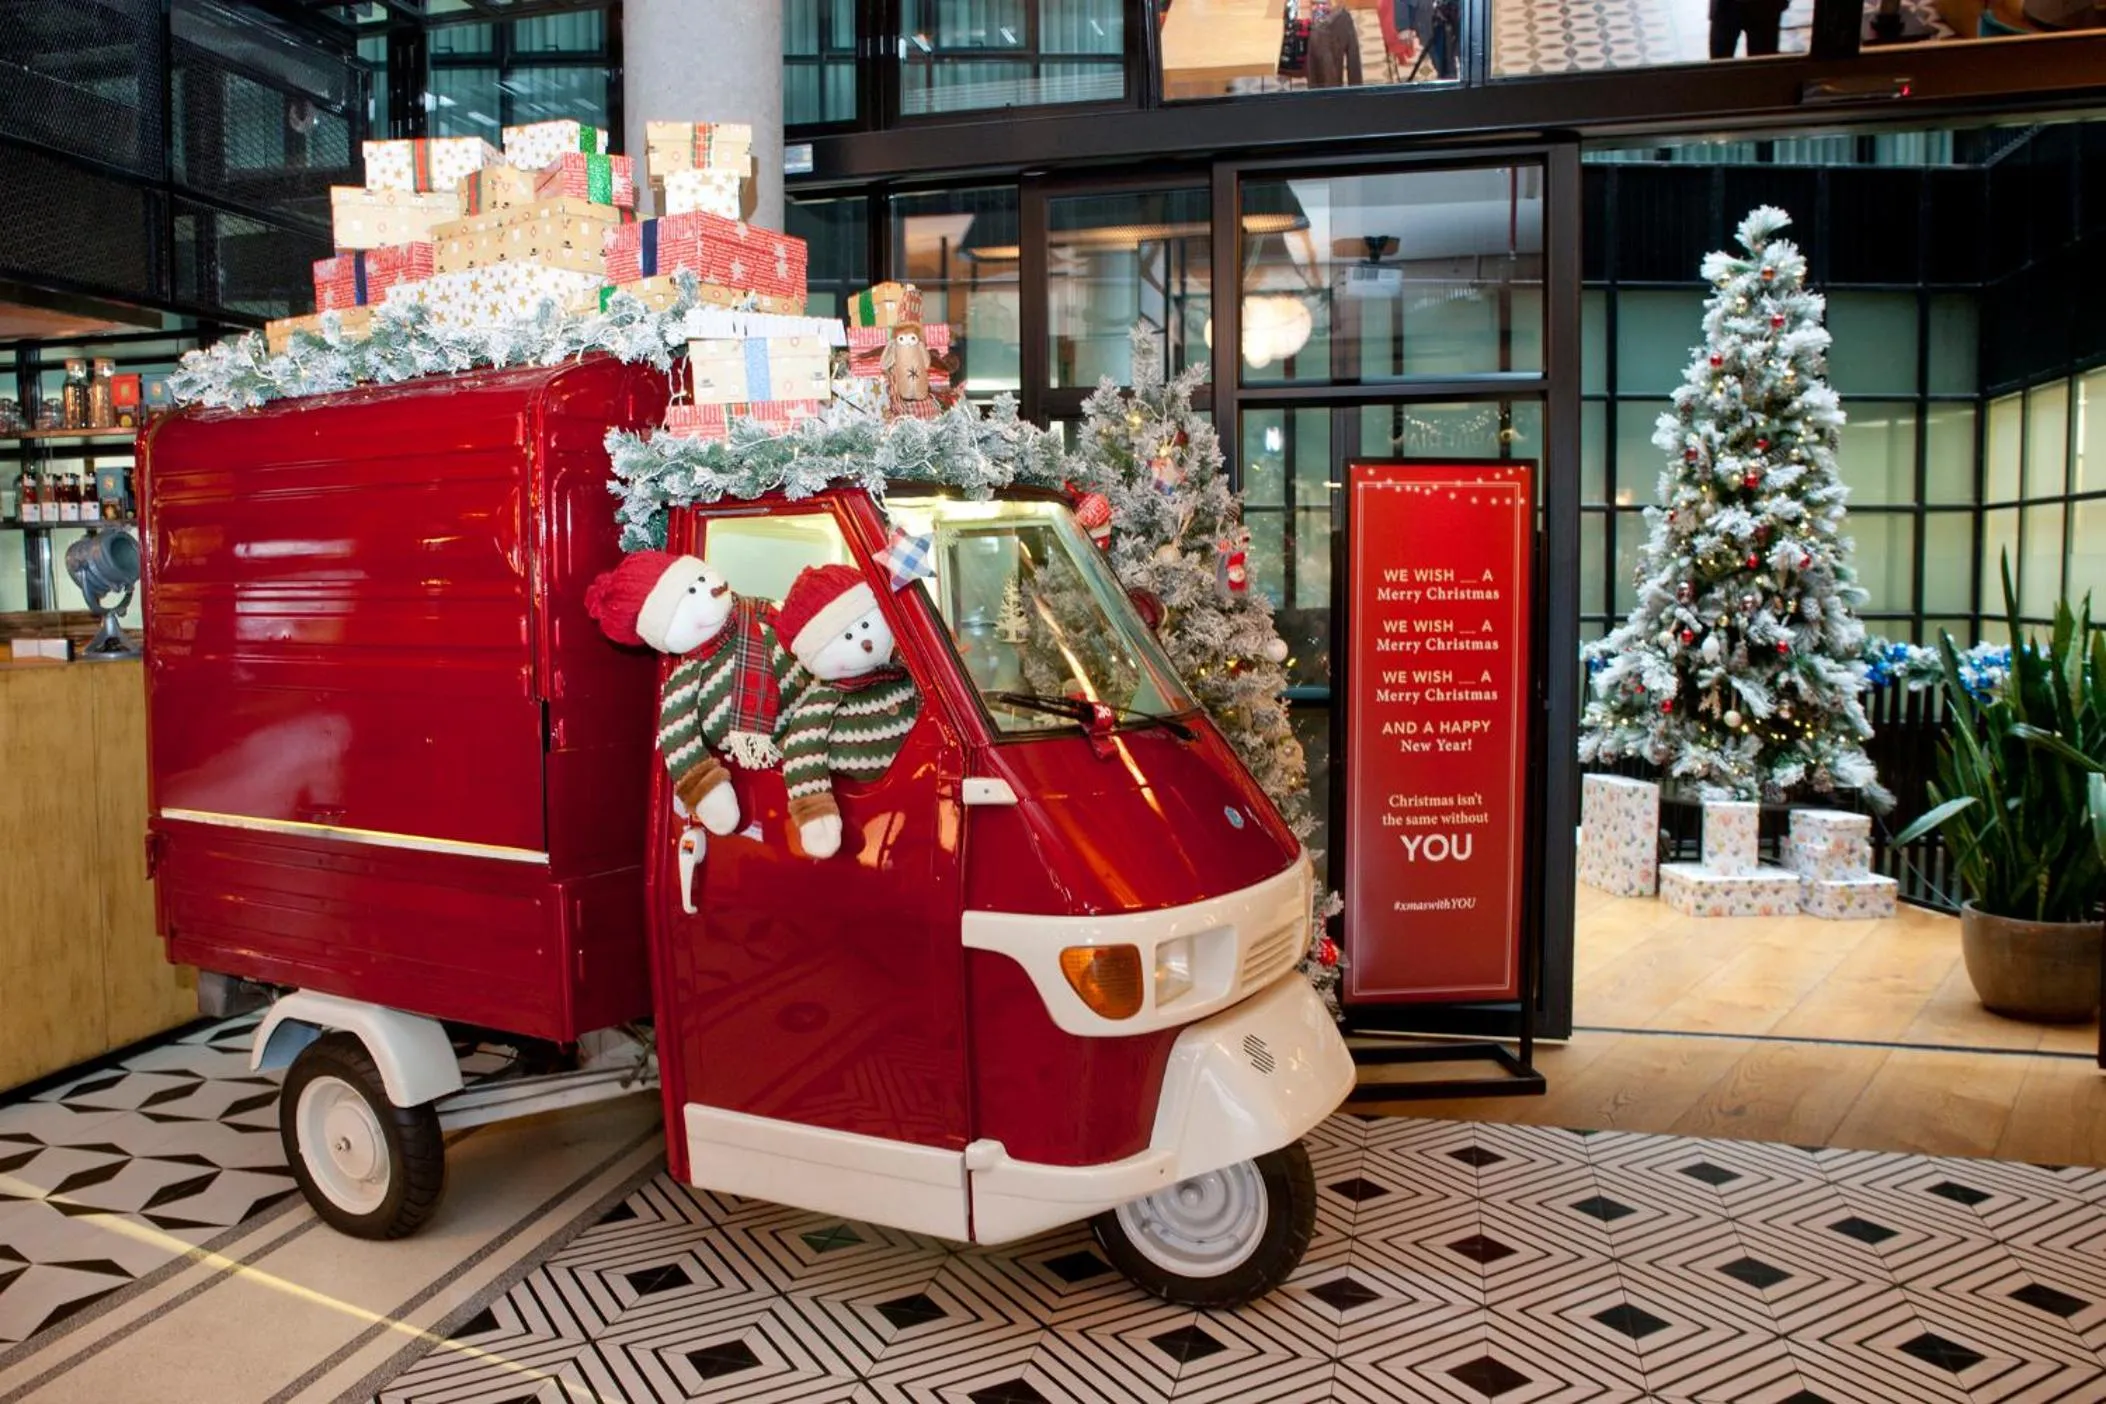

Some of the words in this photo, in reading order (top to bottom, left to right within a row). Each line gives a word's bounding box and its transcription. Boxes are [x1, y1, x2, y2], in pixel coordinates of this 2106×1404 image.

[1383, 568, 1409, 582] WE
[1413, 568, 1455, 582] WISH
[1482, 568, 1494, 582] A
[1377, 587, 1422, 604] Merry
[1426, 586, 1500, 601] Christmas
[1382, 619, 1408, 633] WE
[1413, 619, 1454, 633] WISH
[1481, 619, 1493, 632] A
[1376, 637, 1421, 654] Merry
[1425, 637, 1499, 651] Christmas
[1382, 670, 1408, 684] WE
[1412, 669, 1453, 684] WISH
[1480, 669, 1492, 683] A
[1375, 688, 1421, 705] Merry
[1424, 687, 1498, 702] Christmas
[1382, 720, 1418, 735] AND
[1423, 720, 1435, 734] A
[1439, 719, 1492, 734] HAPPY
[1400, 739, 1432, 753] New
[1436, 738, 1473, 752] Year!
[1388, 794, 1455, 808] Christmas
[1457, 791, 1483, 806] isn't
[1382, 813, 1402, 826] the
[1405, 815, 1439, 826] same
[1440, 811, 1489, 825] without
[1400, 832, 1473, 863] YOU
[1393, 897, 1477, 911] #xmaswithYOU
